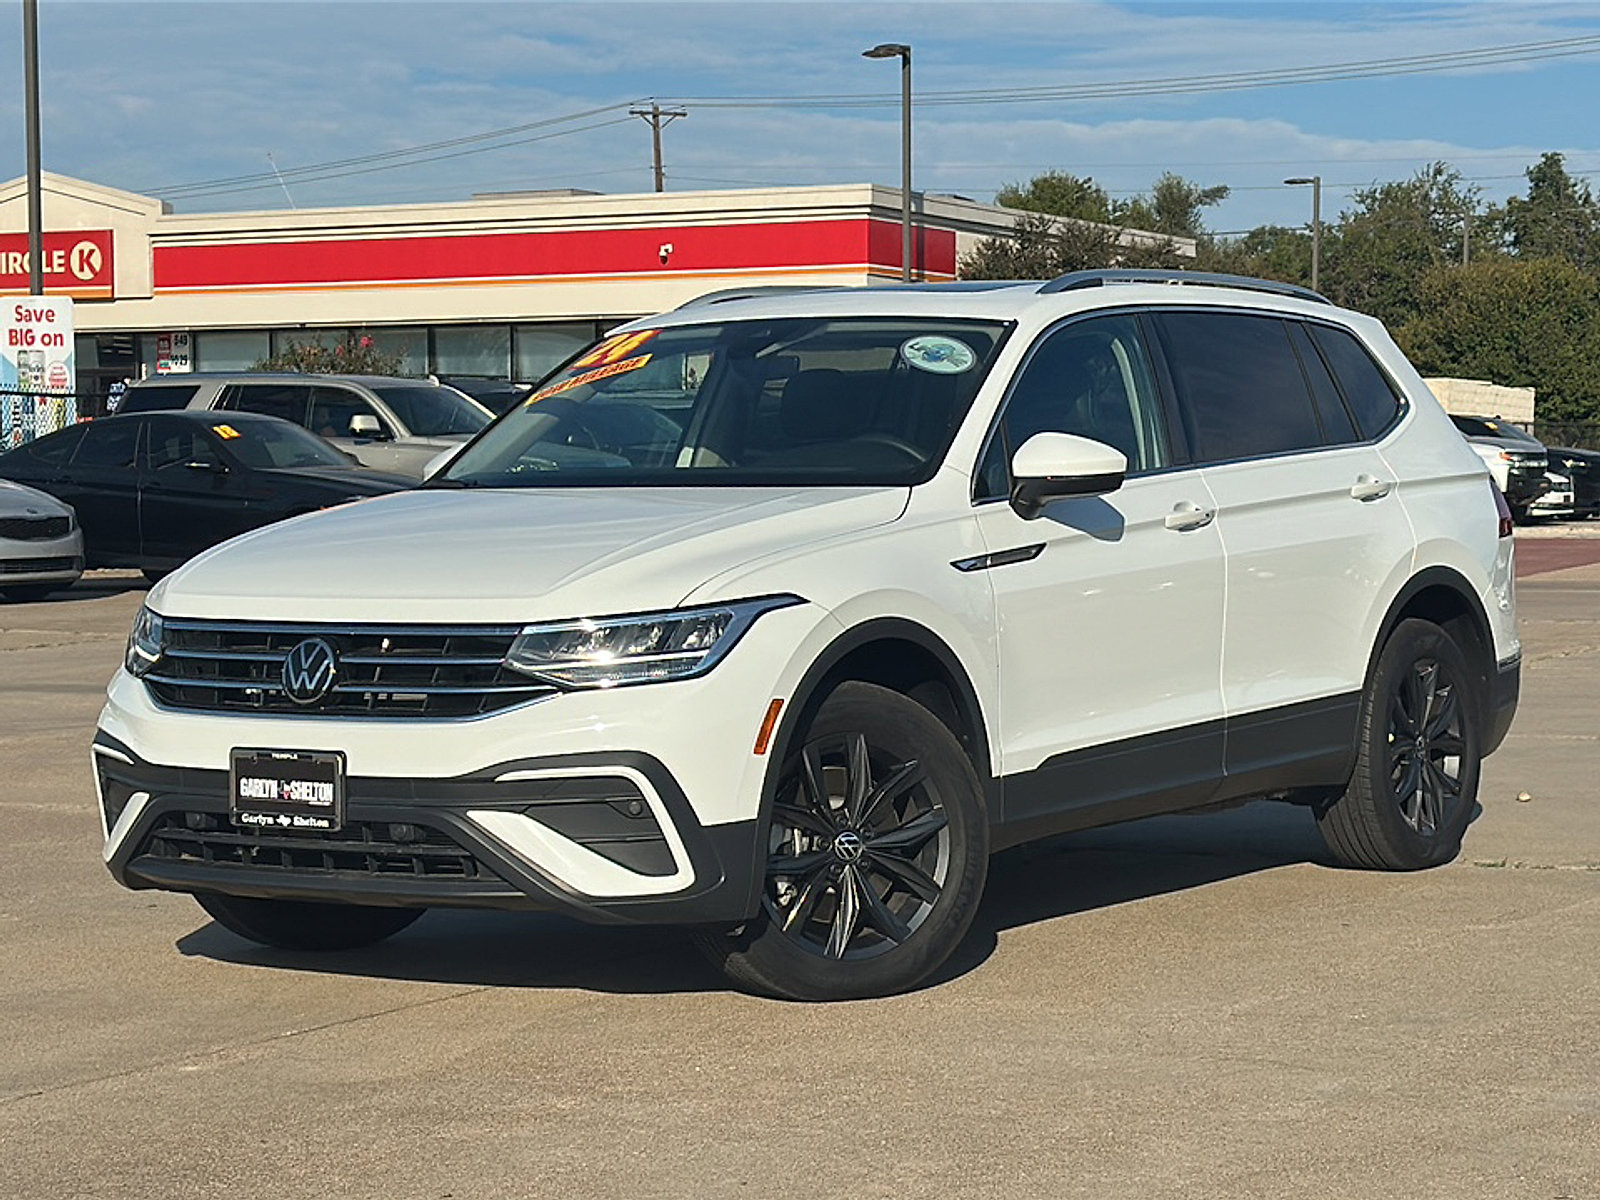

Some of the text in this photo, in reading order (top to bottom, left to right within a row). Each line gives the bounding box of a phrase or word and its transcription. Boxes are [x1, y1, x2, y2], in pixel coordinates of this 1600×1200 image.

[0, 248, 99, 277] IRLE K
[14, 305, 55, 323] Save
[8, 329, 64, 347] BIG on
[289, 780, 334, 803] SHELTON
[241, 813, 330, 828] Garlyn Shelton
